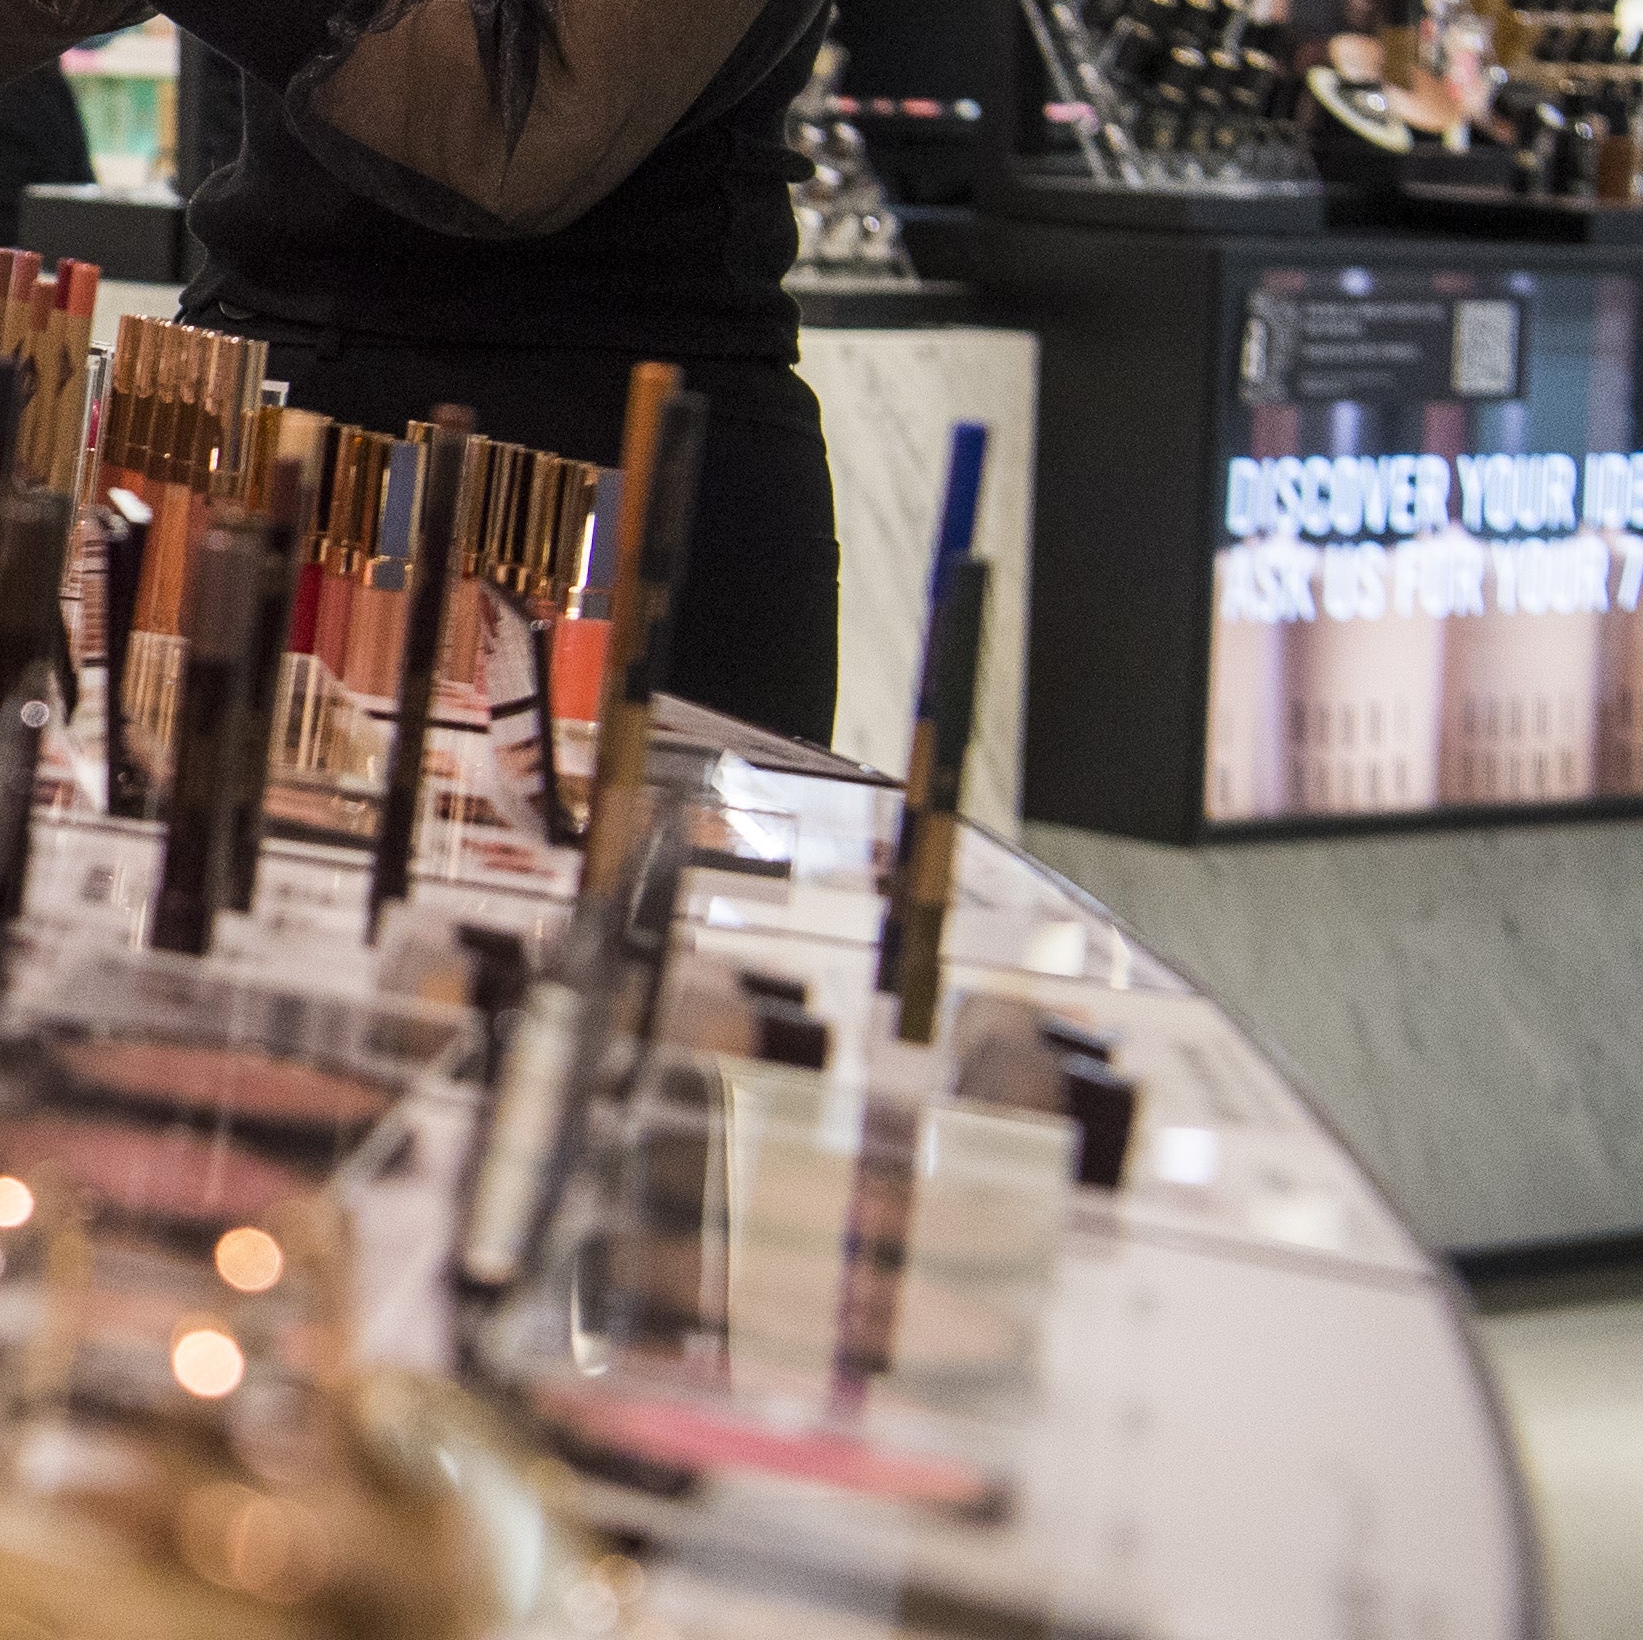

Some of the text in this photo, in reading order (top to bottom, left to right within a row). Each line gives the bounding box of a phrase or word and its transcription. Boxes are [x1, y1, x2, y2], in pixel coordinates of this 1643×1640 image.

[1226, 453, 1451, 537] DISCOVER
[1456, 452, 1578, 533] YOUR
[1221, 541, 1317, 624] ASK
[1321, 540, 1388, 622] US
[1394, 538, 1486, 620] FOR
[1490, 535, 1612, 615] YOUR
